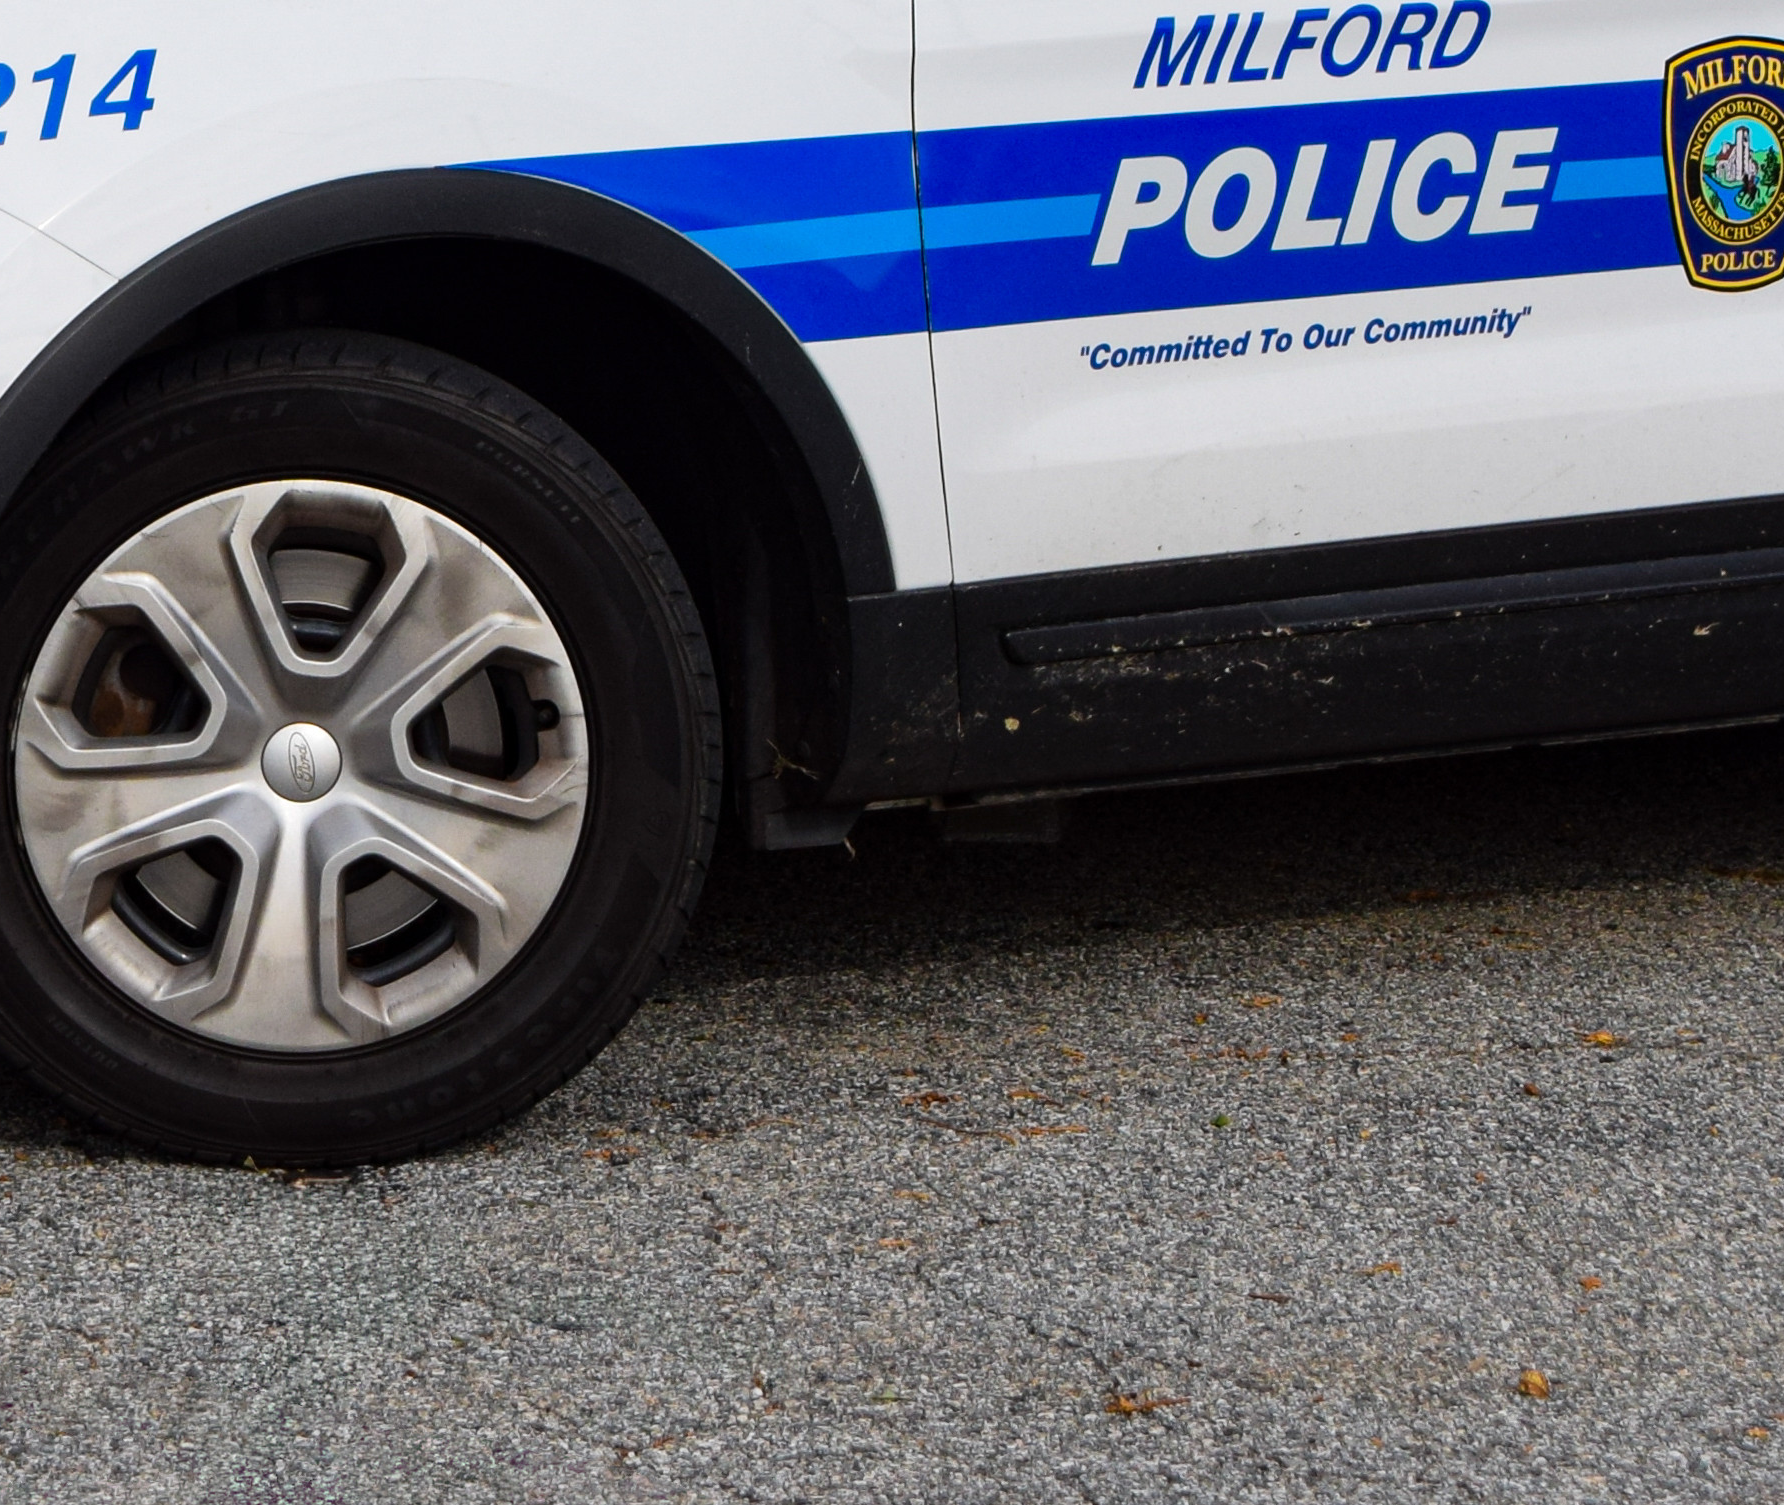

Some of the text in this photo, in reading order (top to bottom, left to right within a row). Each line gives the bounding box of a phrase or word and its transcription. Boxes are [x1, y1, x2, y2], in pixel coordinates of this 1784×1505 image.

[1689, 99, 1779, 162] INCORPORATED
[1091, 127, 1559, 267] POLICE
[1700, 248, 1777, 274] POLICE
[1079, 305, 1533, 372] "Committed To Our Community"
